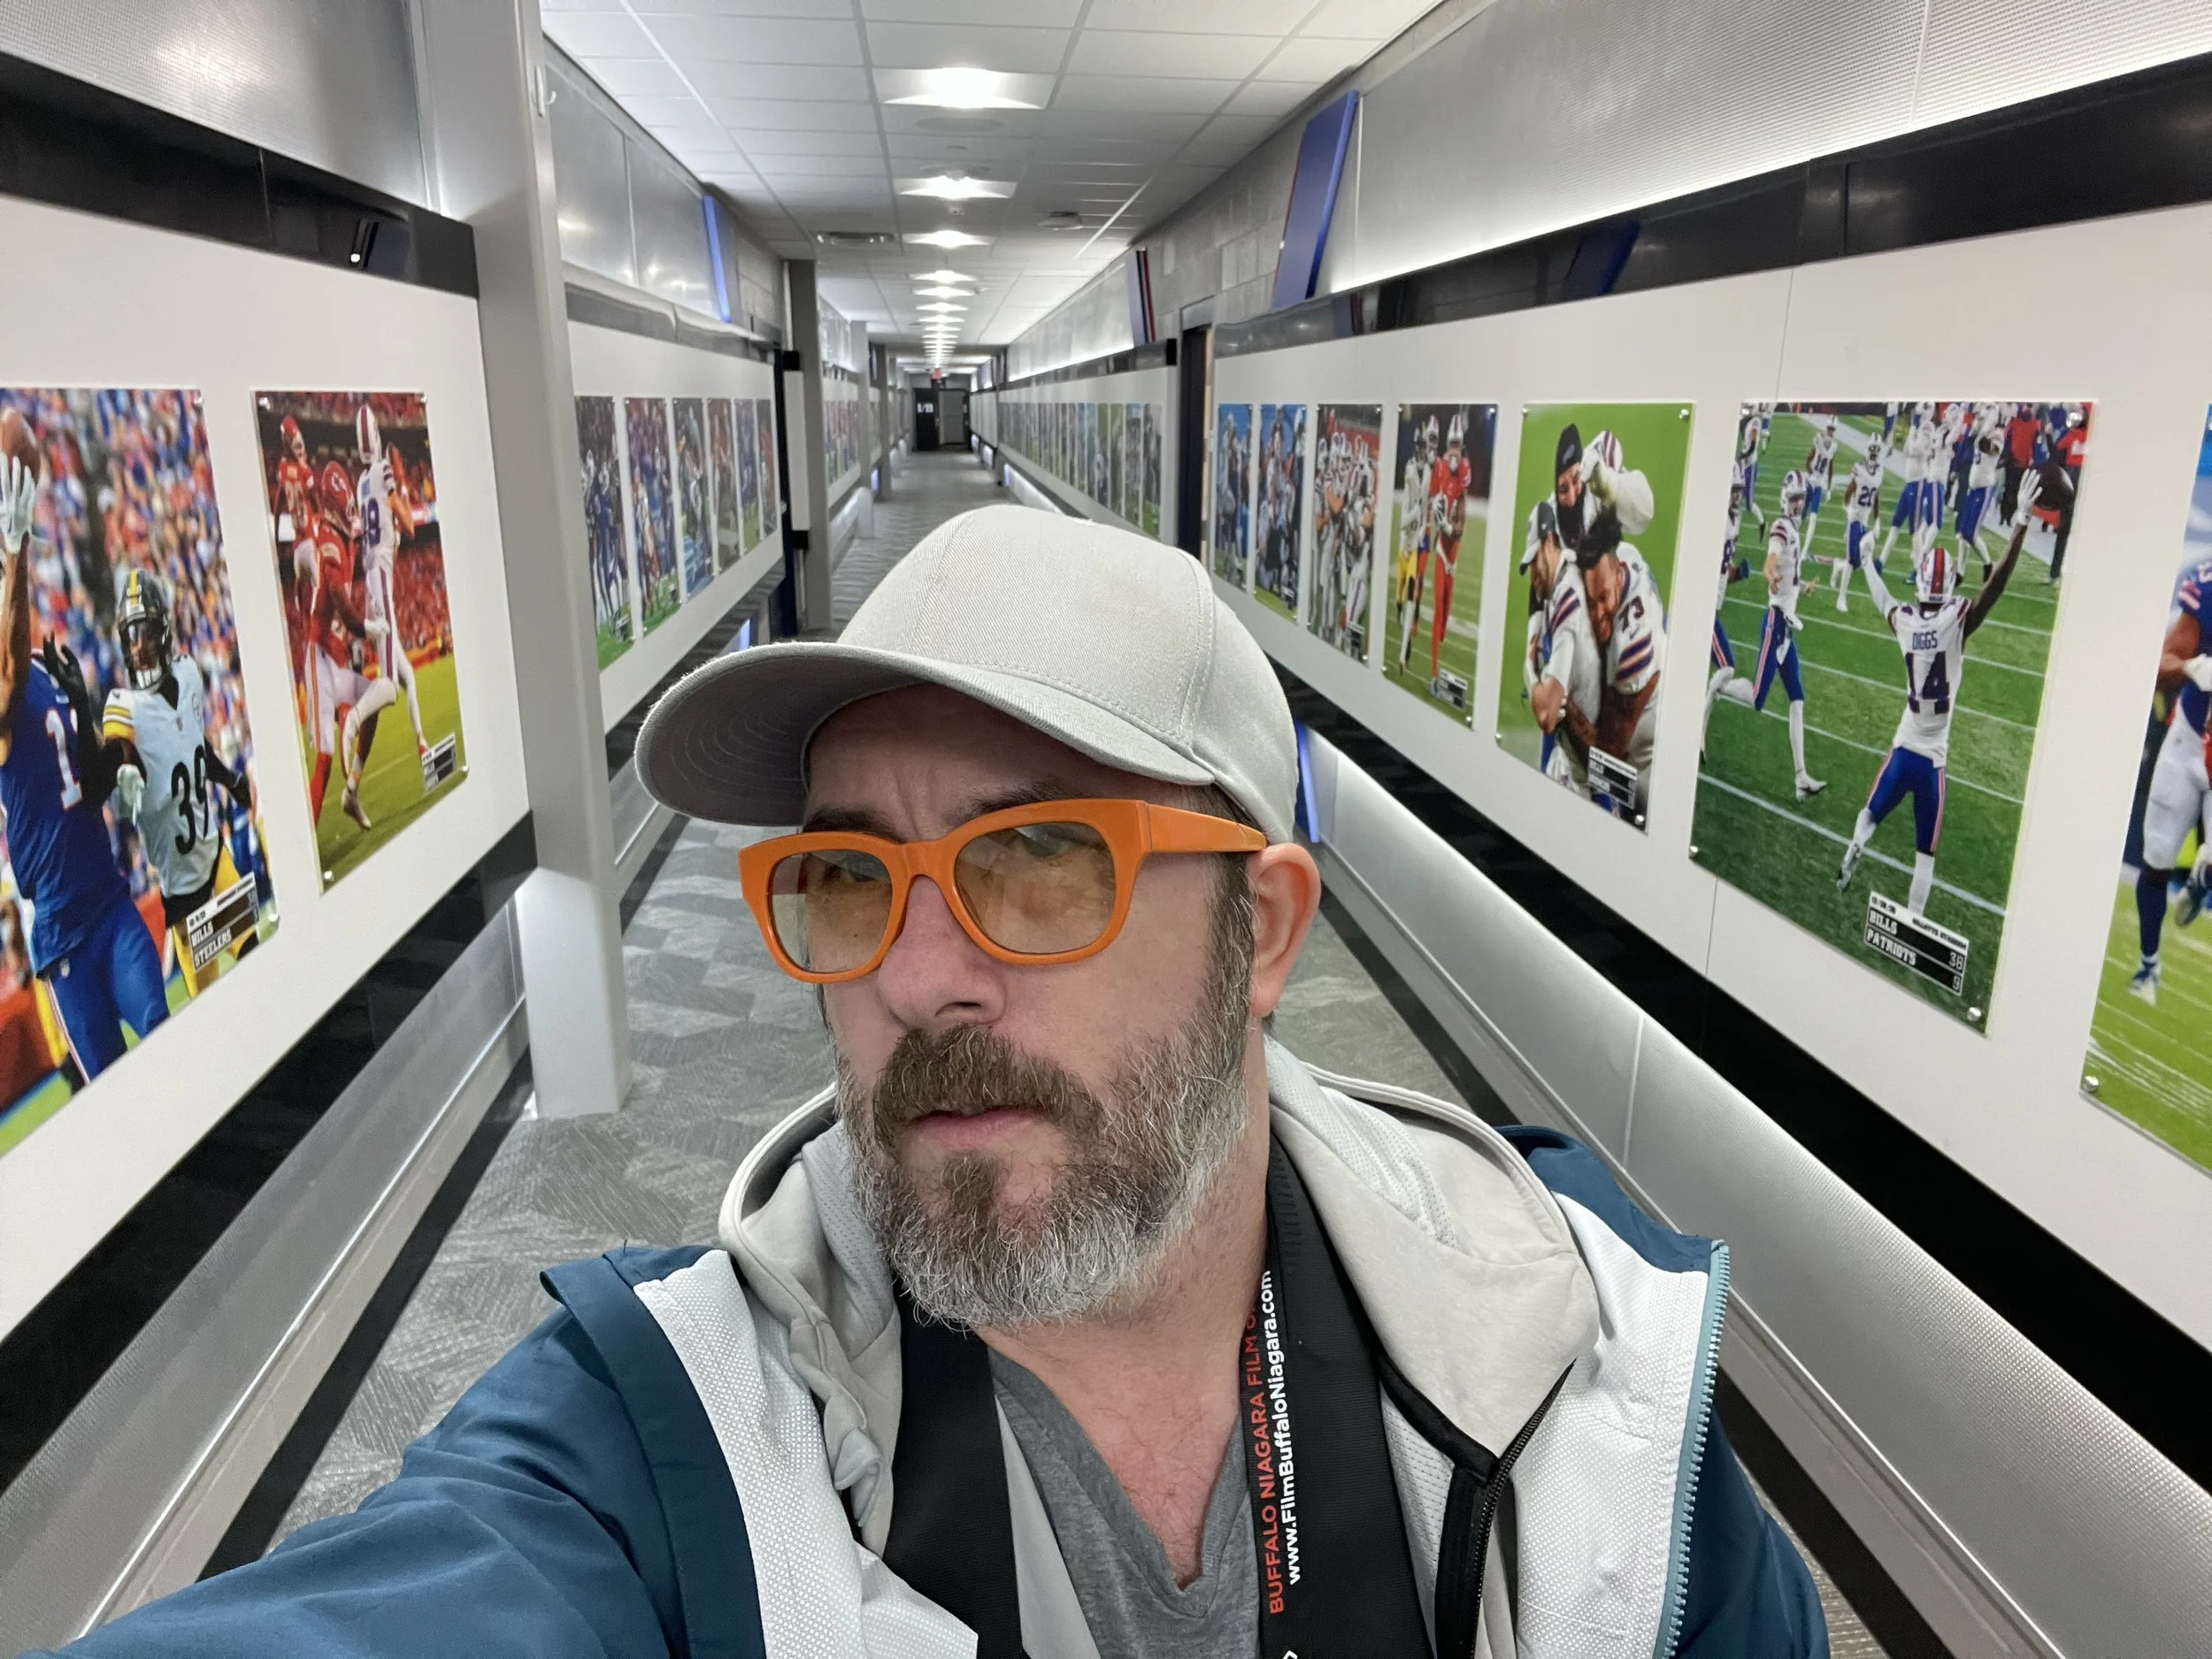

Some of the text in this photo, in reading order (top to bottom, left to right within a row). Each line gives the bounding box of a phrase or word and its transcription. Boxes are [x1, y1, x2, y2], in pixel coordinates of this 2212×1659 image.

[1912, 631, 1938, 650] DIGGS
[1905, 651, 1950, 714] 14
[172, 744, 209, 855] 39
[195, 927, 232, 969] STEELERS
[1867, 928, 1916, 966] PATRIOTS
[1869, 910, 1963, 971] BILLS 38
[1245, 1336, 1263, 1386] FILM
[1249, 1392, 1276, 1499] NIAGARA
[1261, 1270, 1301, 1585] www.FilmBuffaloNiagara.com
[1261, 1504, 1284, 1614] BUFFALO
